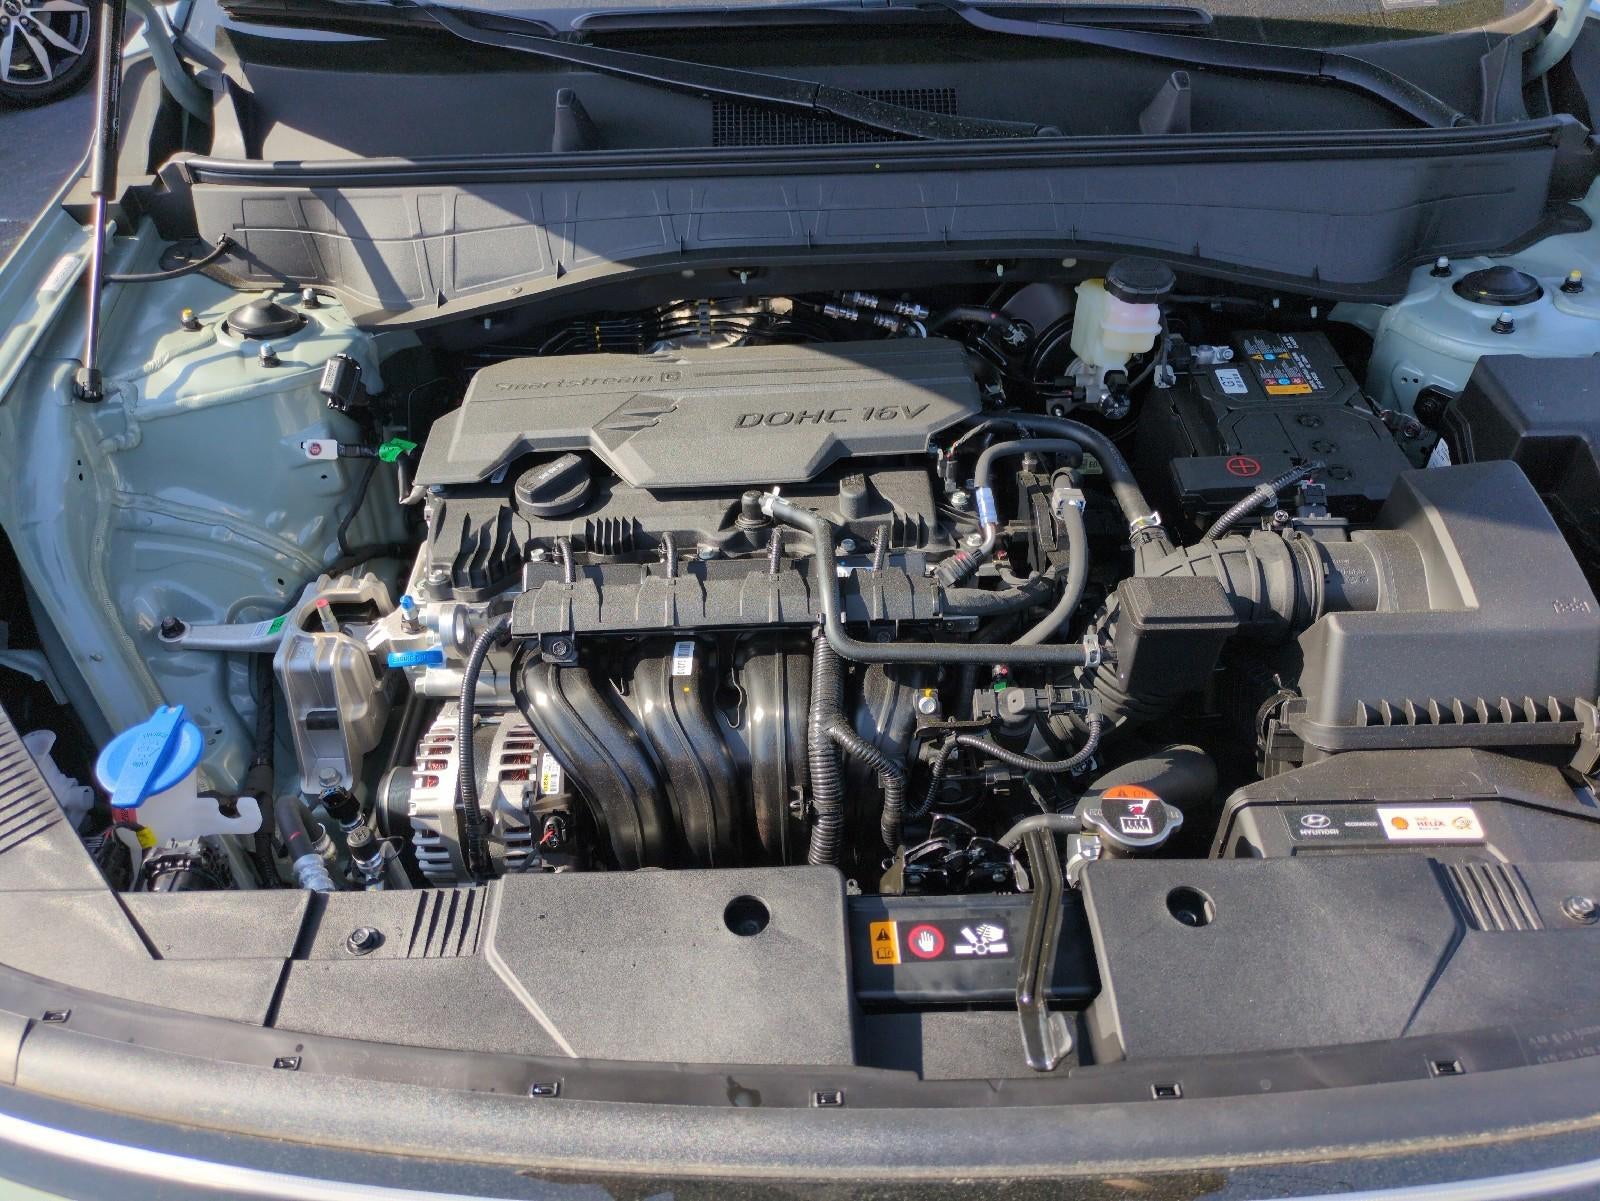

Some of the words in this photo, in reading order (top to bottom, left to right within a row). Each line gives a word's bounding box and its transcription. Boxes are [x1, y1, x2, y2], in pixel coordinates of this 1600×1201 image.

[496, 375, 655, 391] Smartstream
[734, 408, 853, 429] DOHC
[862, 403, 931, 422] 16V
